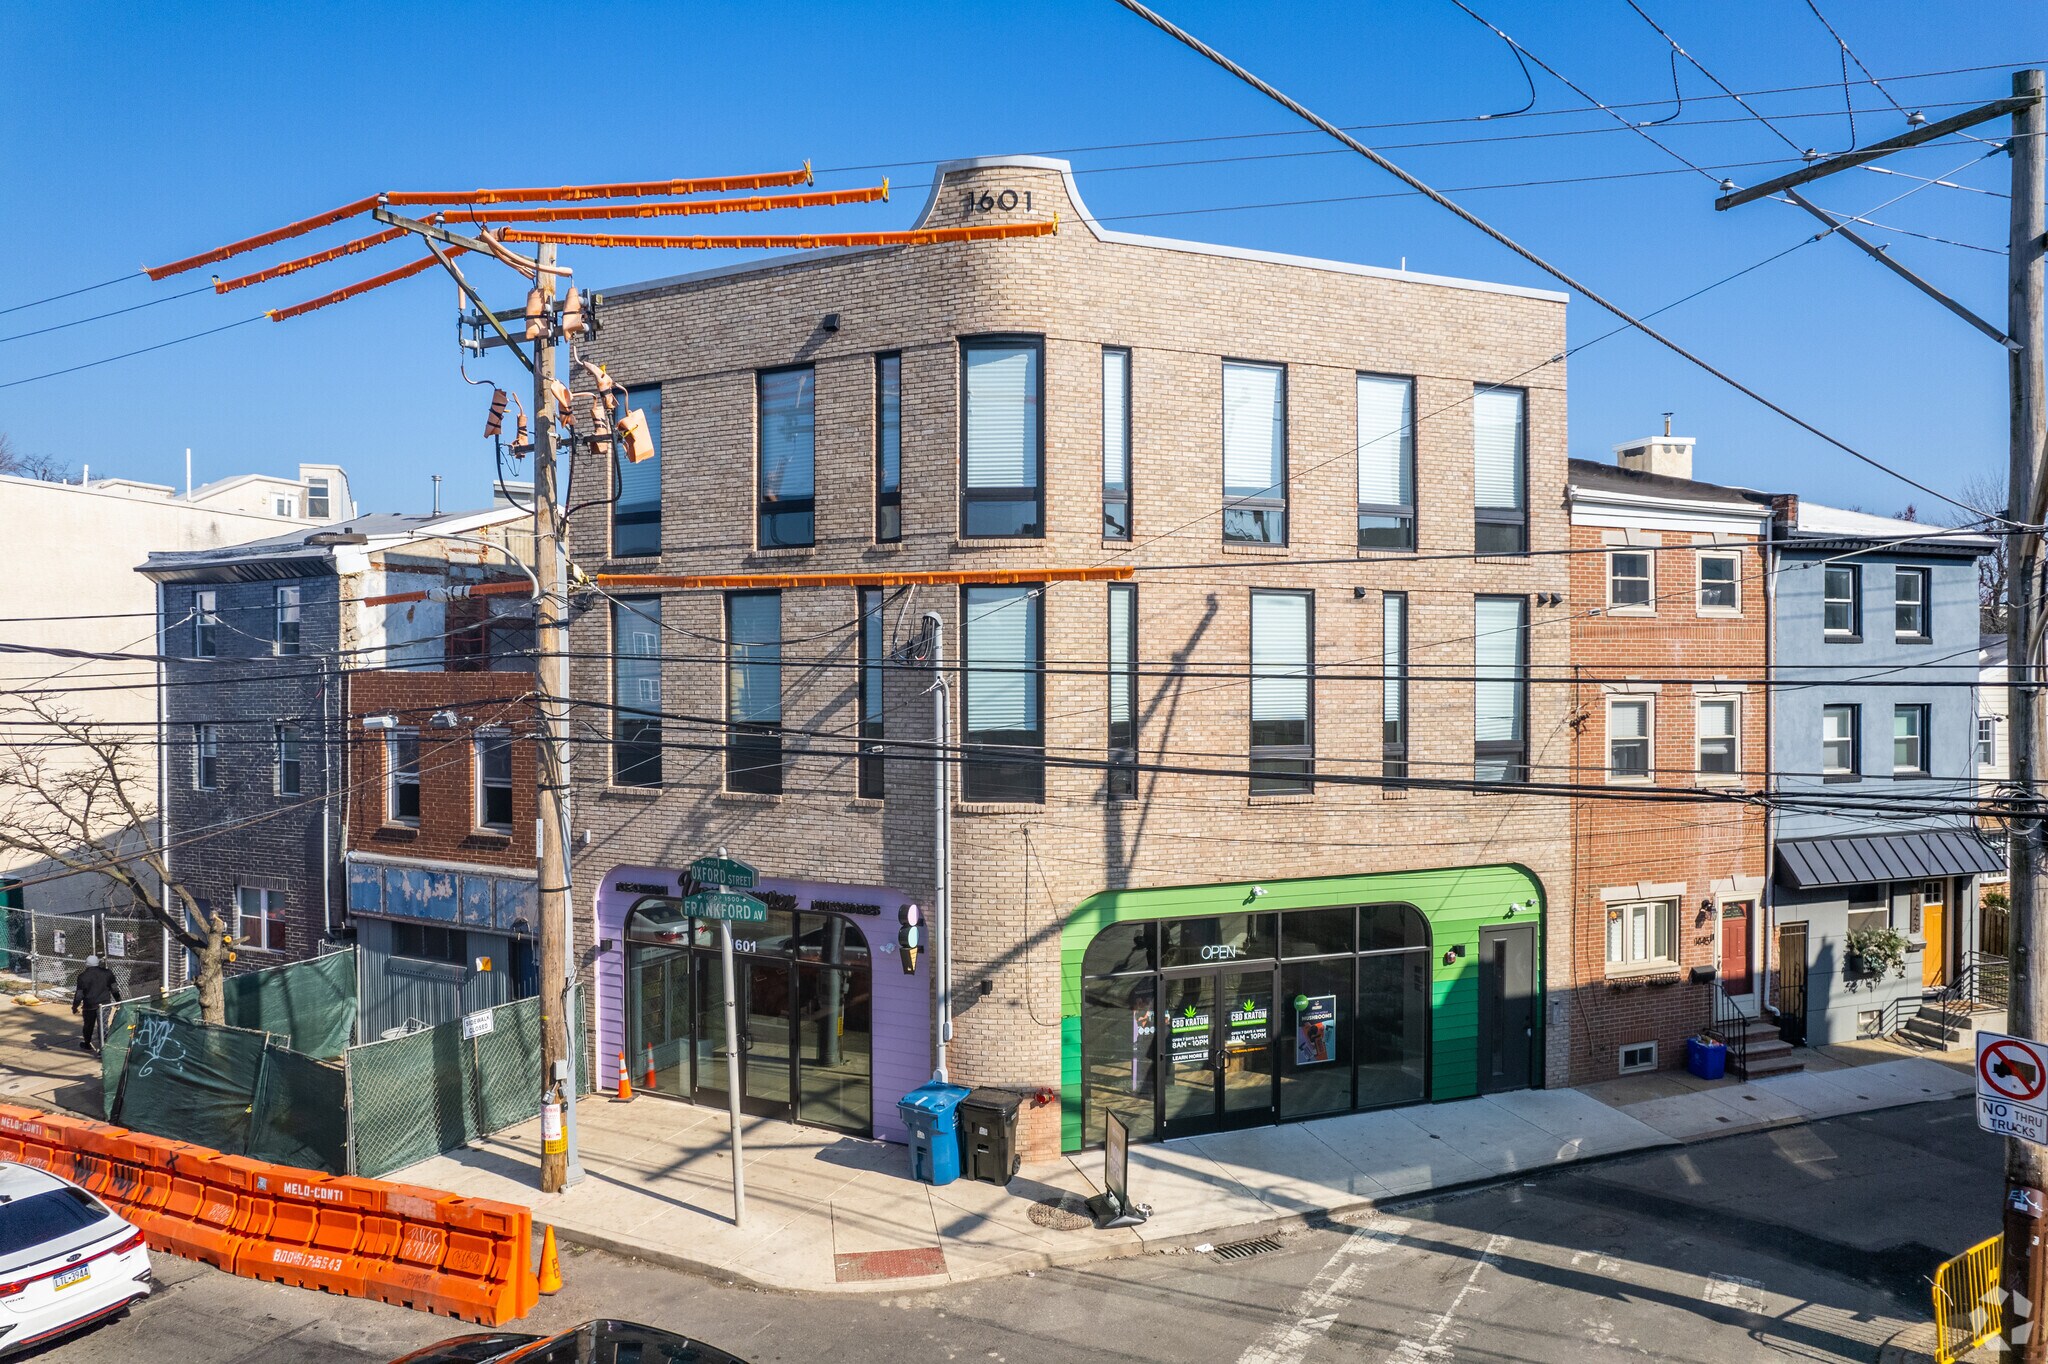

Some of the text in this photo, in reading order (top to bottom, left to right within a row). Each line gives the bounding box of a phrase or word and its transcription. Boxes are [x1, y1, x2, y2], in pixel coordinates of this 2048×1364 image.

[968, 189, 1032, 212] 1601
[691, 866, 752, 887] OXFORD STREET
[684, 901, 764, 920] FRANKFORD AV
[1201, 945, 1236, 960] OPEN
[465, 1016, 490, 1027] SIDEWALK
[1172, 1016, 1209, 1028] CBD KRATOM
[1231, 1010, 1267, 1021] CBD KRATOM
[1302, 1013, 1332, 1021] MUSHROOMS
[469, 1023, 488, 1034] CLOSED
[1250, 1032, 1266, 1040] 10PM
[1172, 1041, 1187, 1049] 8AM
[1192, 1039, 1209, 1047] 10PM
[1983, 1101, 2043, 1128] NO THRU
[1, 1116, 42, 1136] MELO-CONTI
[1990, 1117, 2036, 1138] TRUCKS
[283, 1182, 343, 1202] MELO-CONTI
